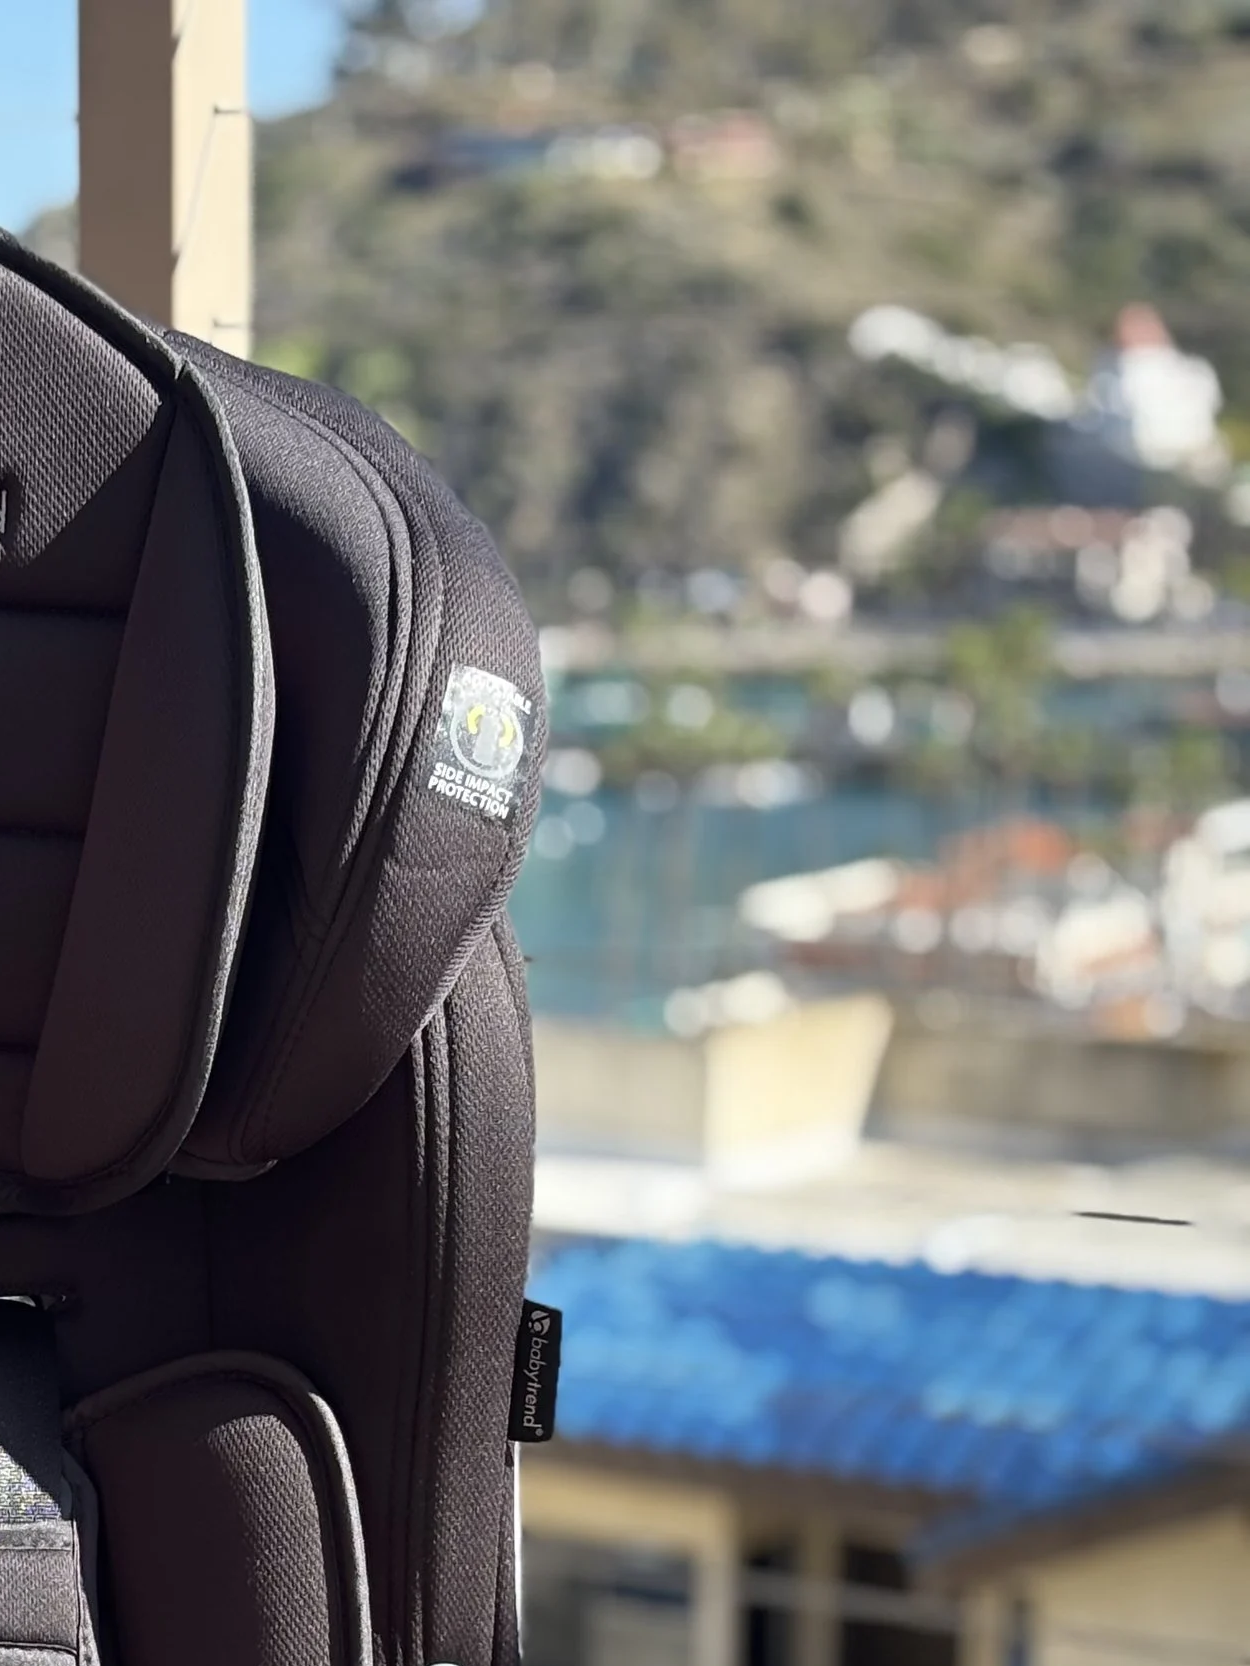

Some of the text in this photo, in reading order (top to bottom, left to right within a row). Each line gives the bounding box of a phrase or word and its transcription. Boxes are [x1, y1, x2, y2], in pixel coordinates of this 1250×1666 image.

[427, 776, 510, 820] PROTECTION
[433, 763, 513, 804] SIDE IMPACT
